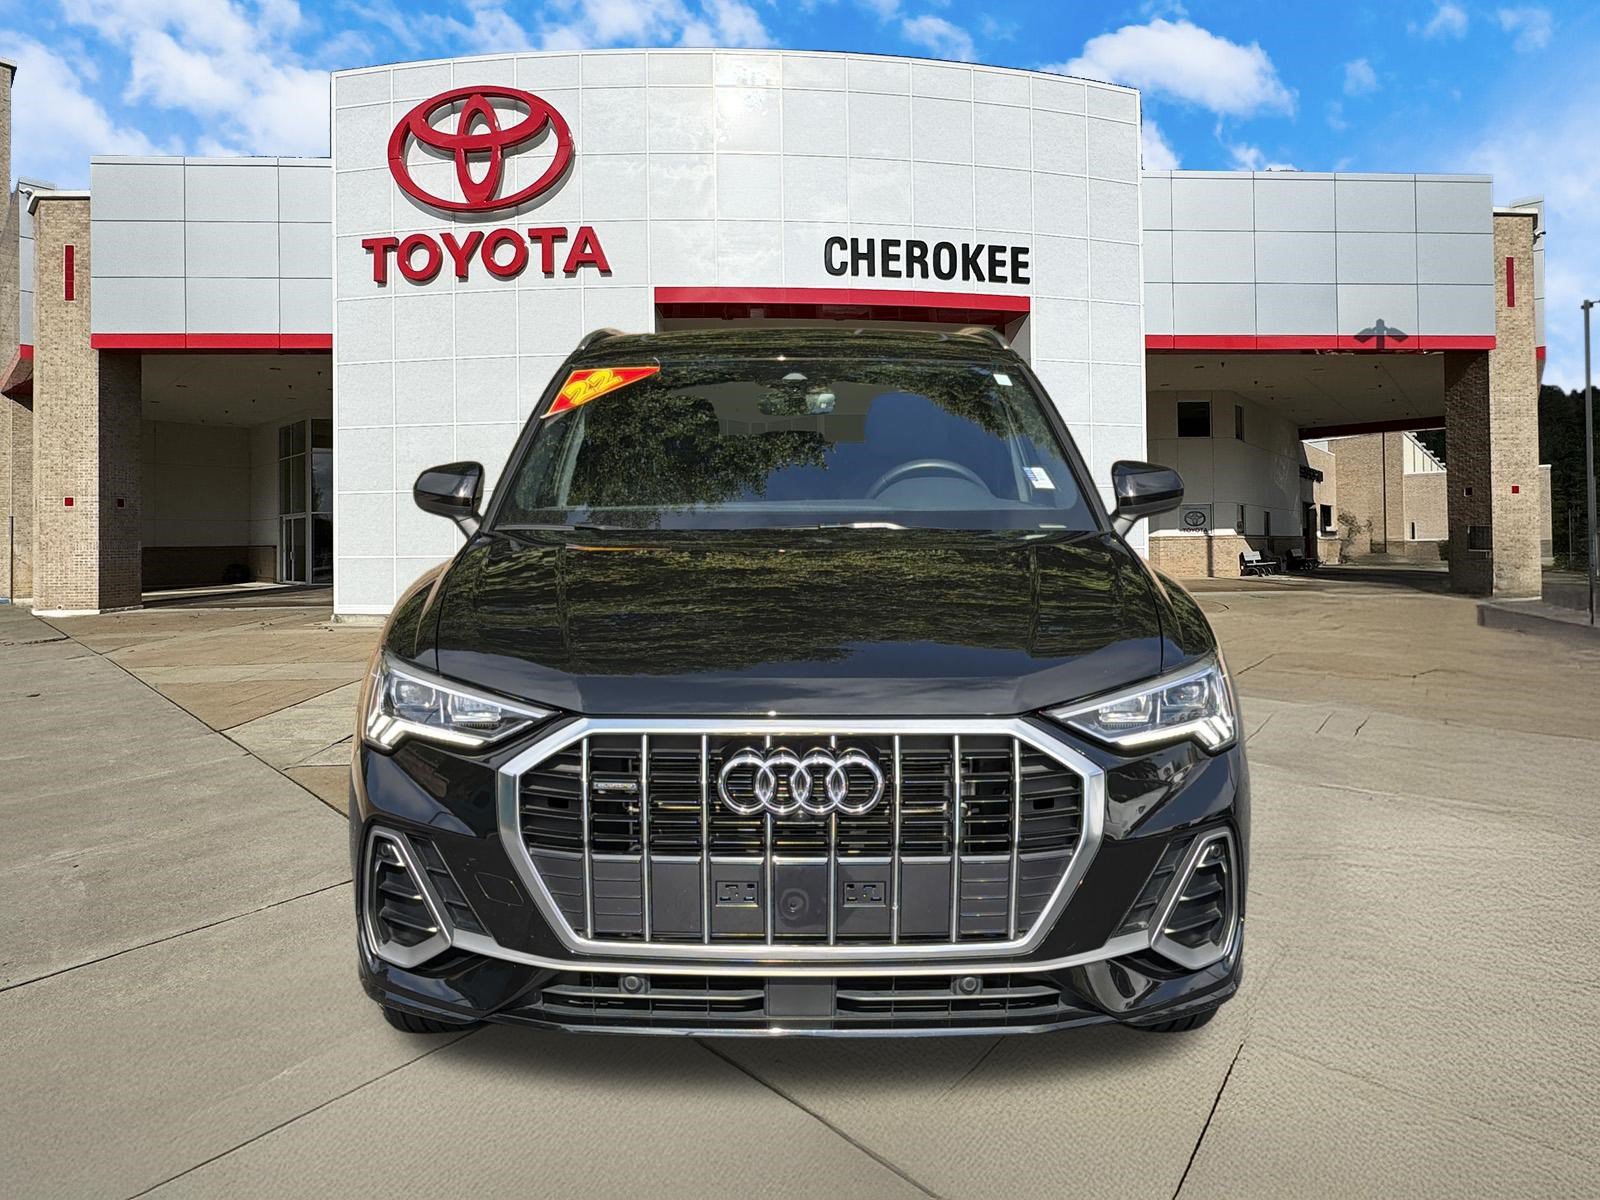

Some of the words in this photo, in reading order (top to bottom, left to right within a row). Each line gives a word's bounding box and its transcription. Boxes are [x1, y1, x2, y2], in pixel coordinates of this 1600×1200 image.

[362, 226, 611, 285] TOYOTA
[824, 236, 1031, 284] CHEROKEE
[562, 369, 623, 406] 22
